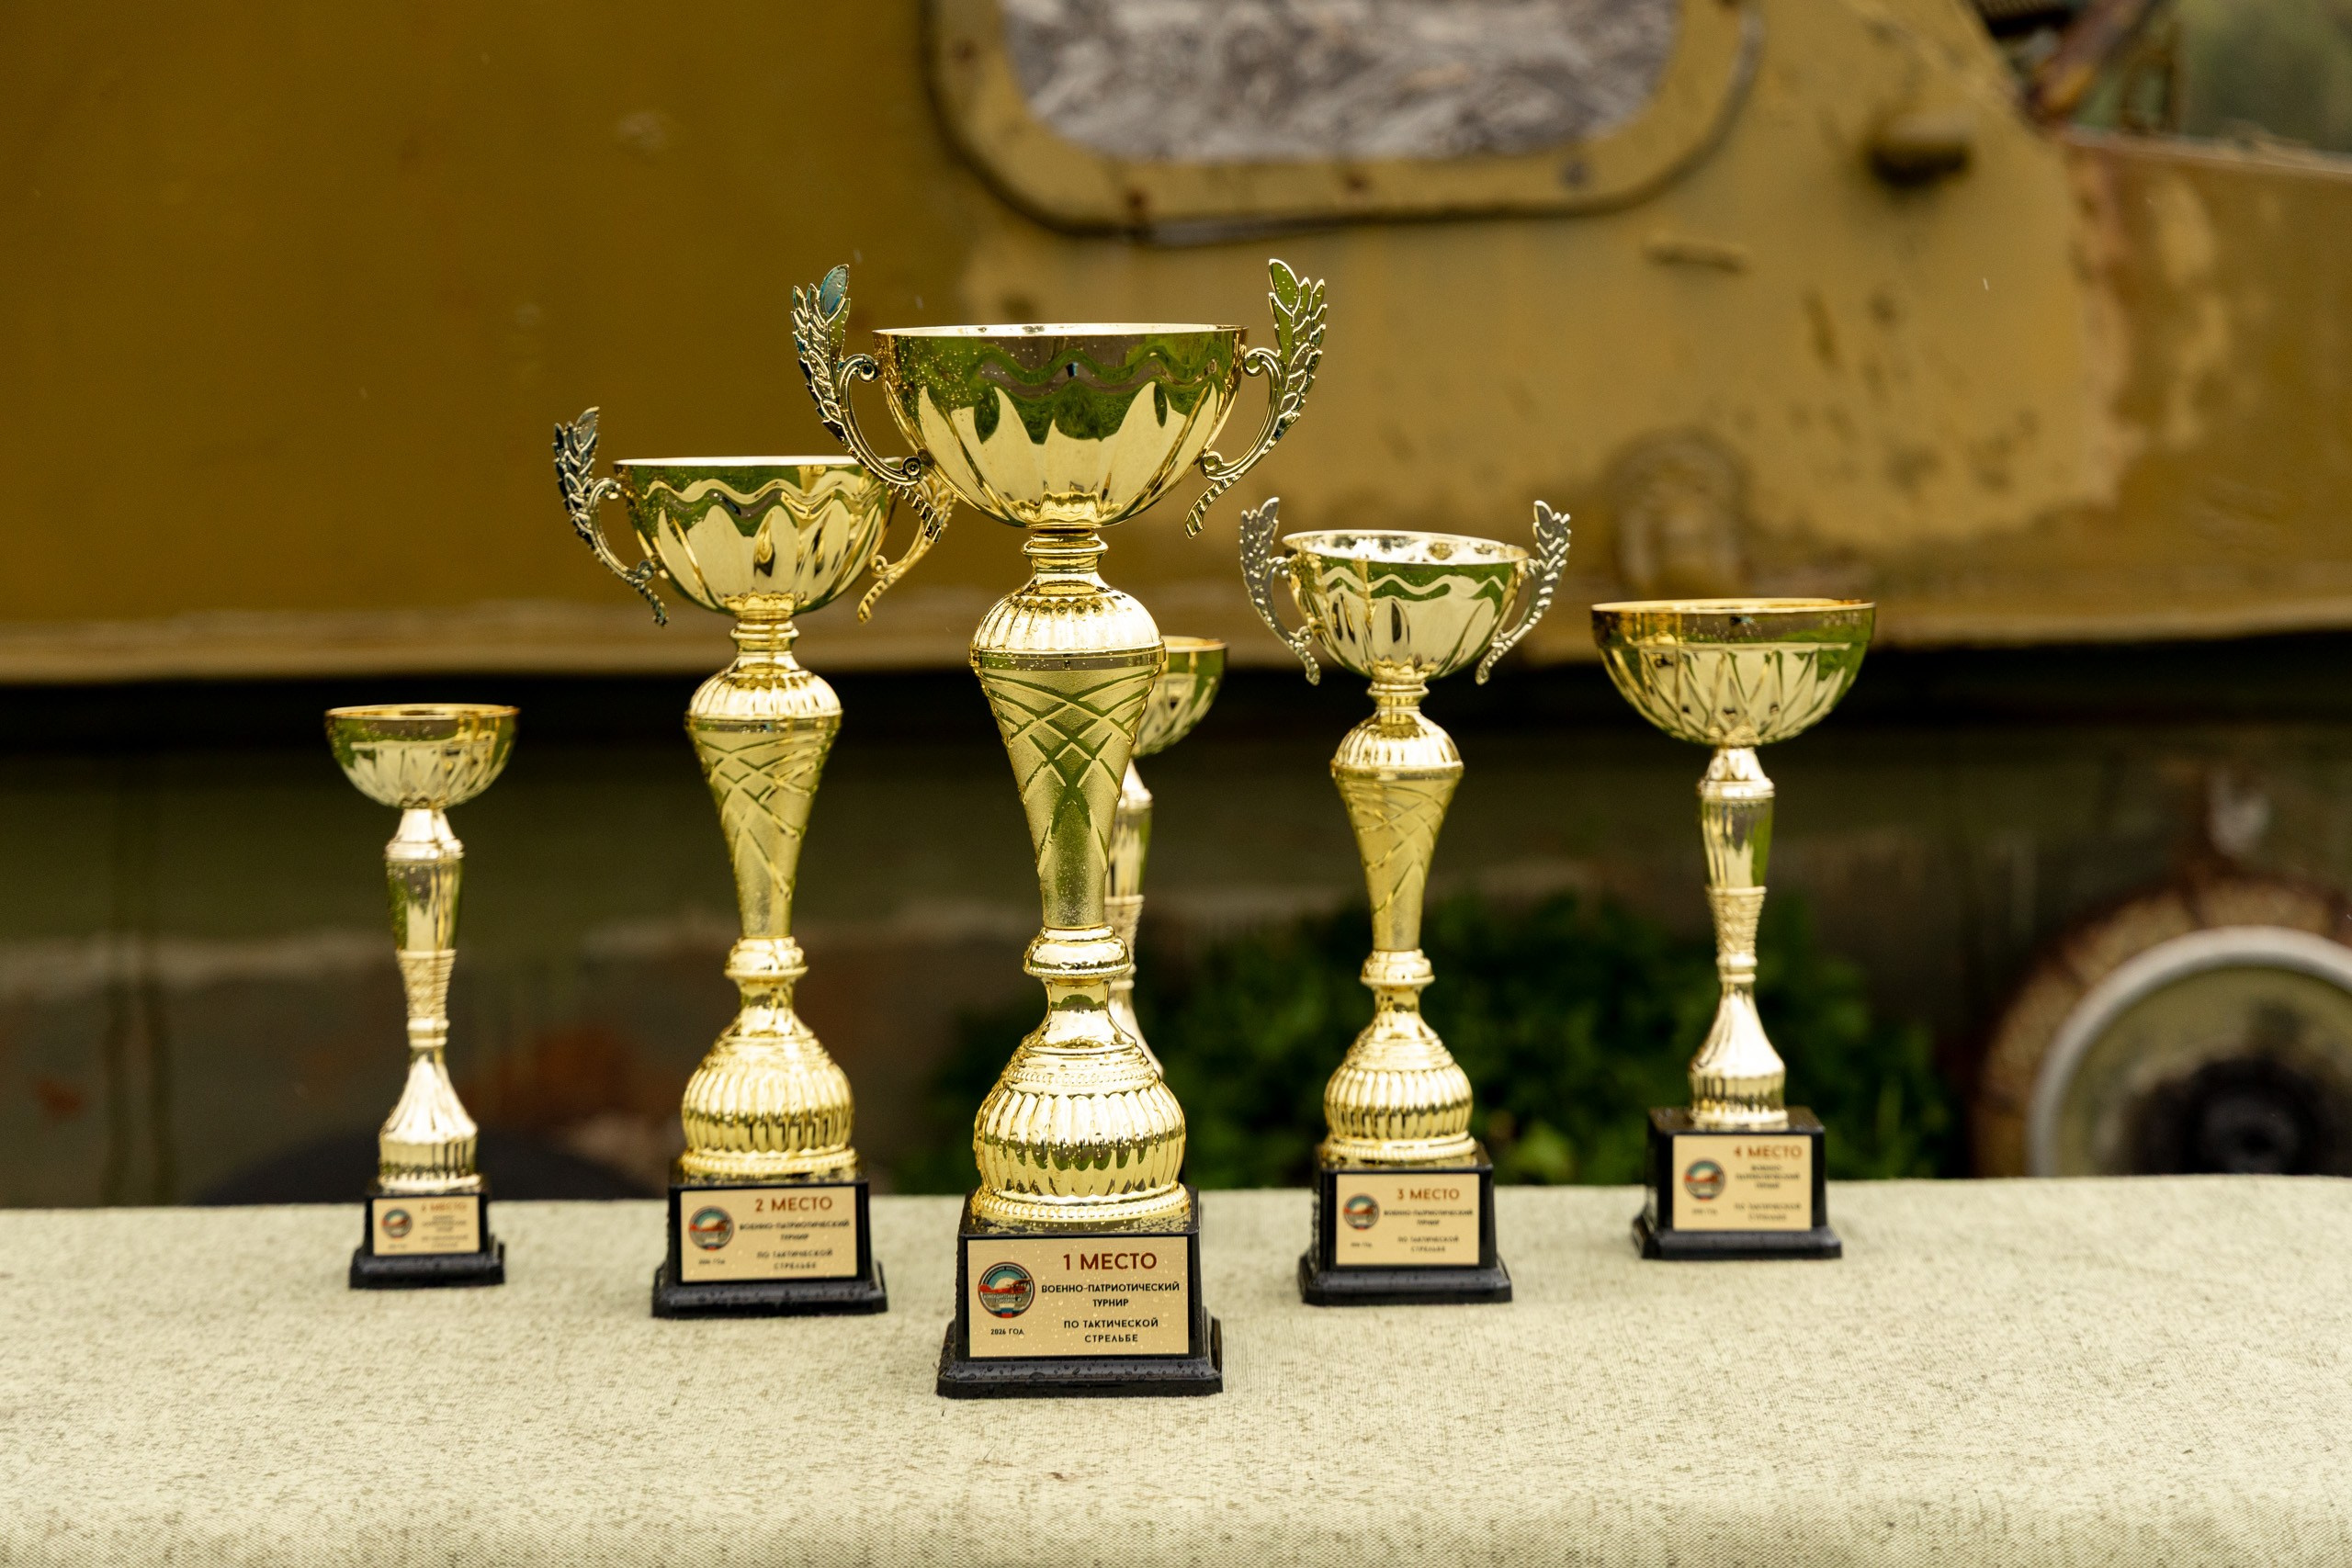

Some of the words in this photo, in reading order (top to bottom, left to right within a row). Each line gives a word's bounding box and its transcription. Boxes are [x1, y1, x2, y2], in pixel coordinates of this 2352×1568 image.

[1747, 1145, 1803, 1158] МЕСТО
[1397, 1189, 1404, 1200] 3
[1410, 1188, 1460, 1200] МЕСТО
[755, 1198, 763, 1213] 2
[771, 1196, 832, 1212] МЕСТО
[1063, 1253, 1071, 1270] 1
[1080, 1252, 1158, 1270] МЕСТО
[1041, 1280, 1180, 1293] ВОЕННО-ПАТРИОТИЧЕСКИЙ
[1093, 1298, 1129, 1308] ТУРНИР
[1064, 1320, 1080, 1329] ПО
[1083, 1317, 1159, 1329] ТАКТИЧЕСКОЙ
[1009, 1327, 1024, 1336] ГОД
[1084, 1334, 1138, 1343] СТРЕЛЬБЕ
